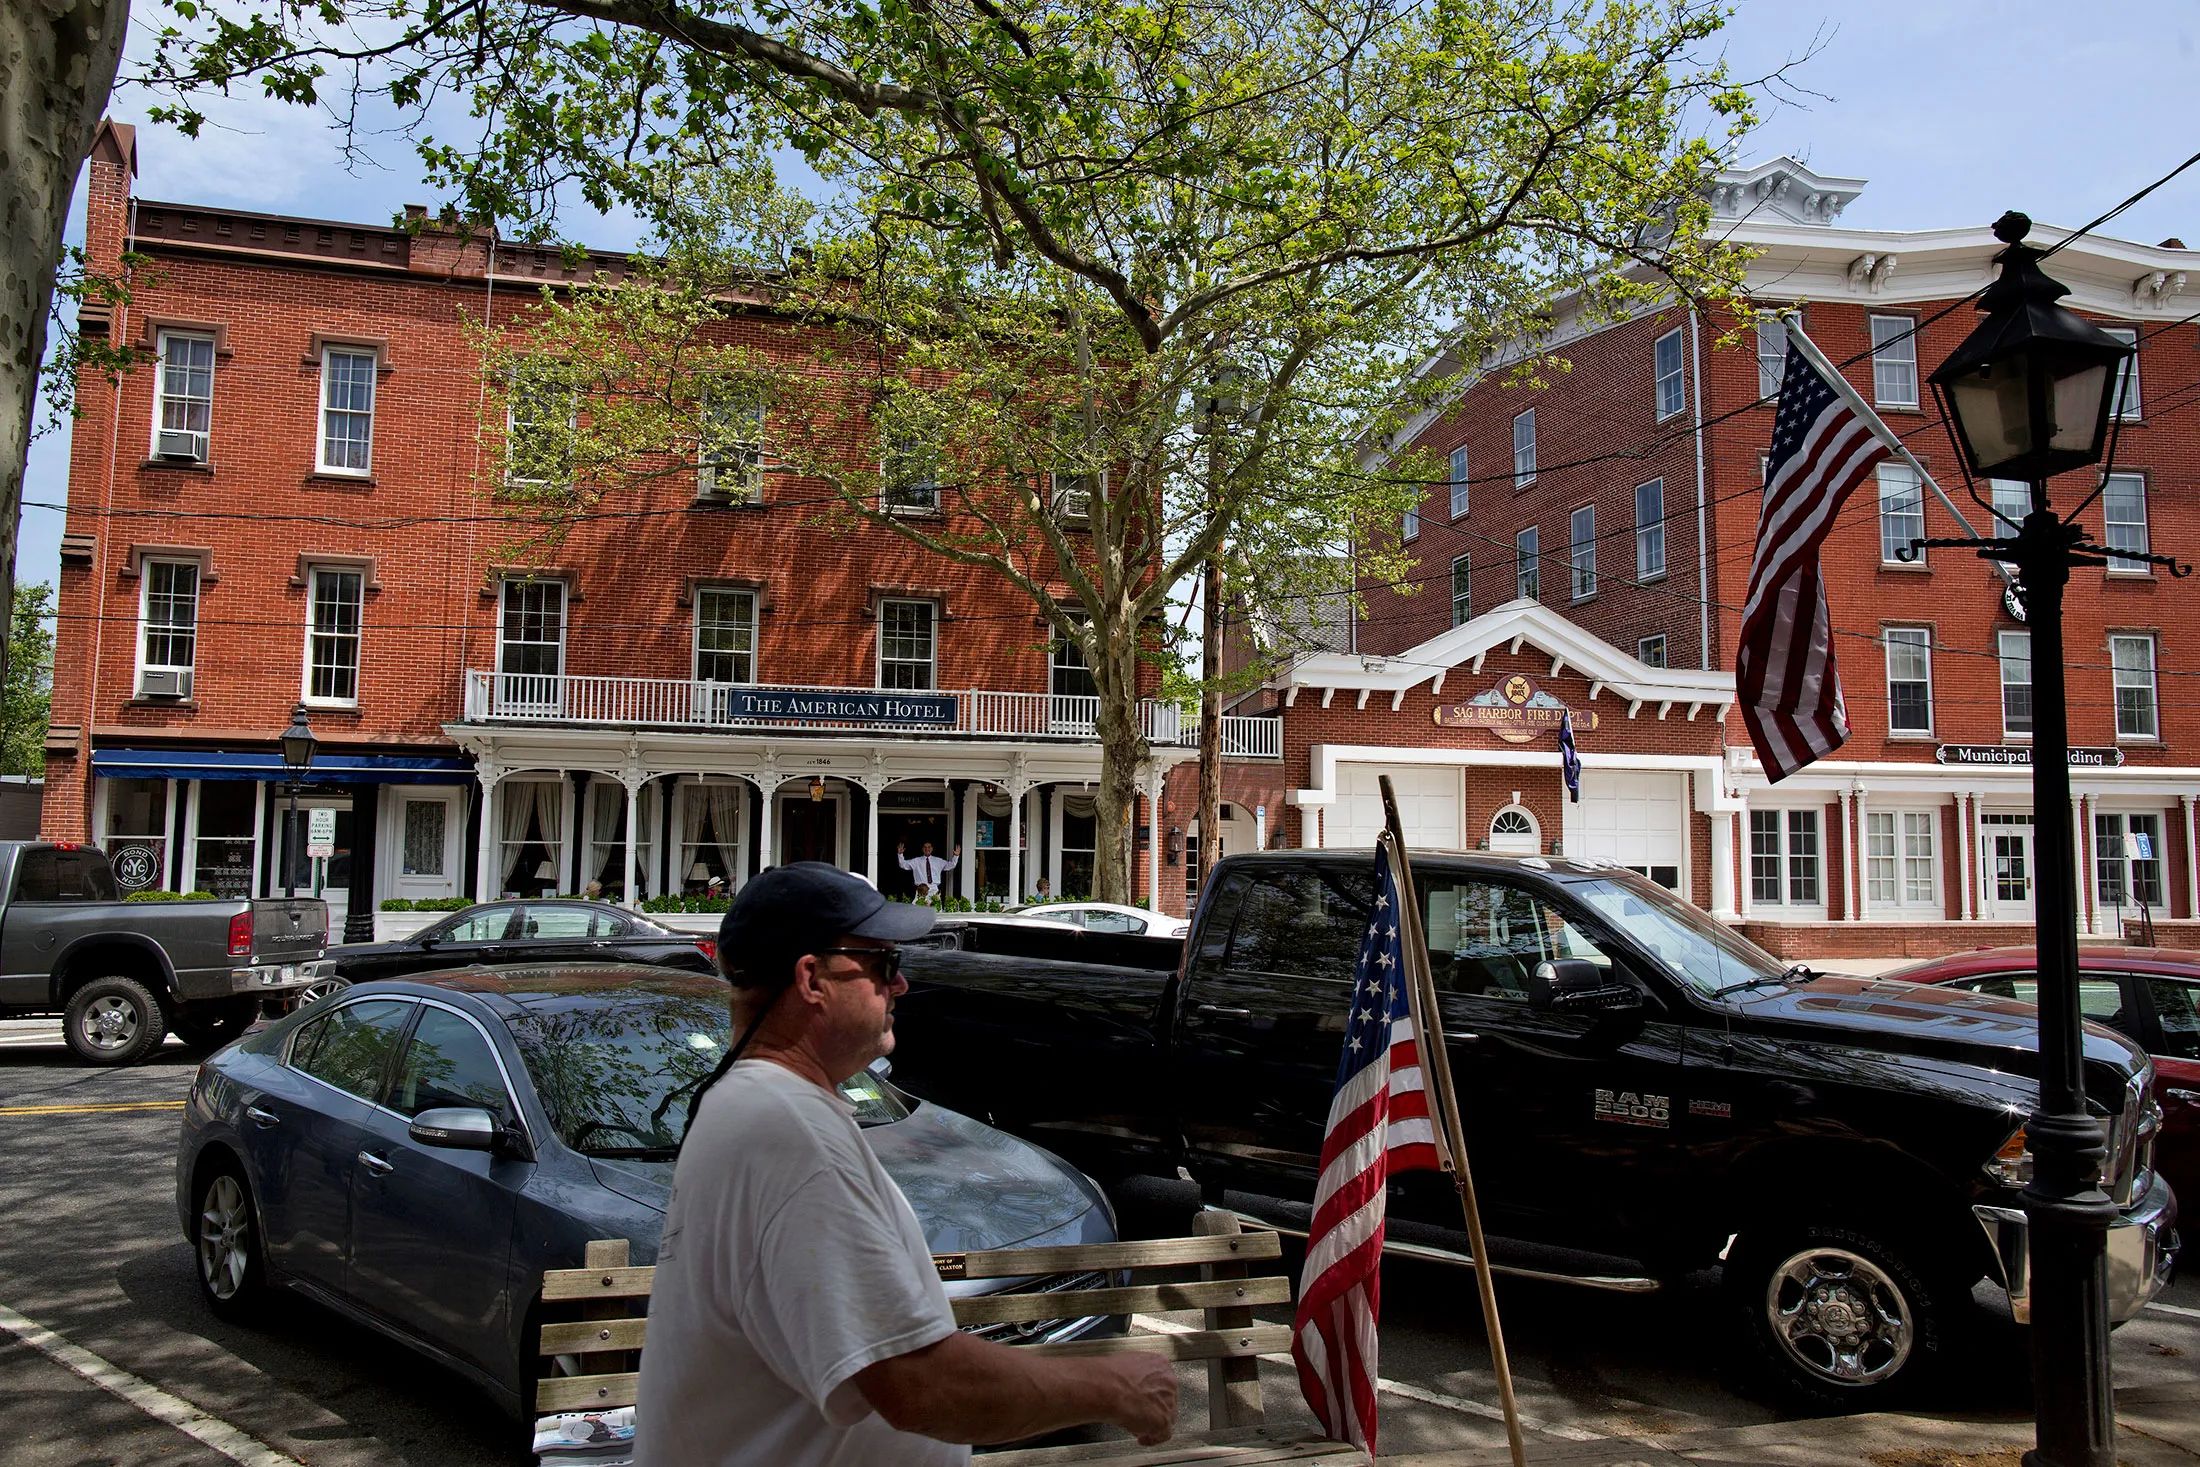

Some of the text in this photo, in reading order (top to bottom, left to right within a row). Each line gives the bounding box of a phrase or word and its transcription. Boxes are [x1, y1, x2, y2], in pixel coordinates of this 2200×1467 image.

[741, 695, 945, 718] THE AMERICAN HOTEL
[1453, 706, 1473, 718] SAG
[1478, 707, 1522, 719] HARBOR
[1527, 709, 1552, 720] FIRE
[1958, 747, 2103, 766] Municipal lding
[123, 849, 148, 858] BOND
[124, 858, 146, 876] NYC
[121, 876, 138, 885] NO.
[1595, 1088, 1670, 1109] RAM
[1595, 1100, 1670, 1121] 2500
